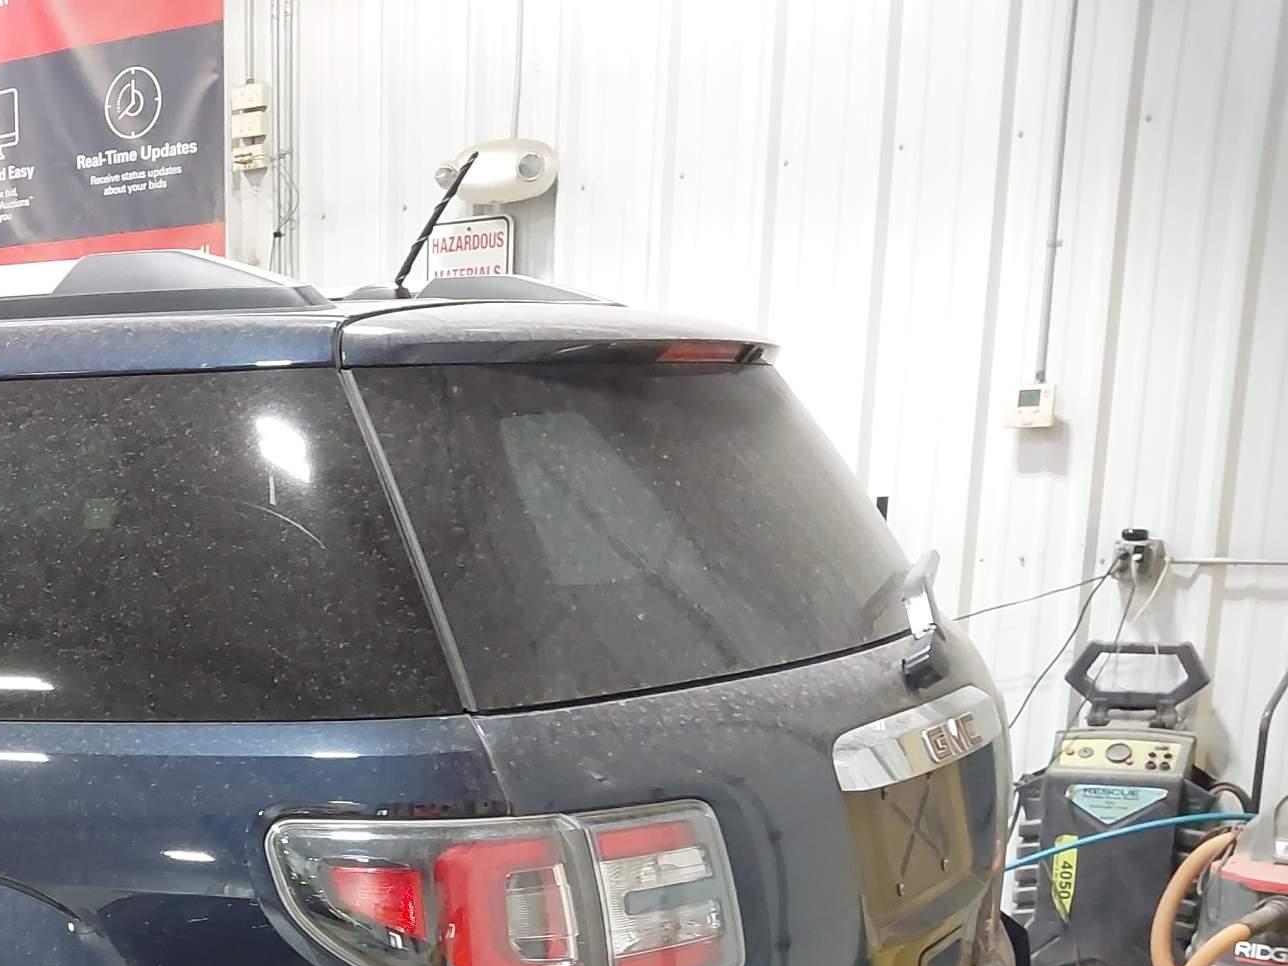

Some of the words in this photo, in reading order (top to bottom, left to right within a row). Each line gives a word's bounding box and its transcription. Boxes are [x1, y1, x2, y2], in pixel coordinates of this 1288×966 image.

[76, 150, 138, 169] Real-Time
[140, 142, 198, 162] Updates
[8, 165, 35, 180] Easy
[90, 173, 121, 185] Receive
[121, 170, 146, 181] status
[147, 166, 183, 178] updates
[103, 185, 127, 196] about
[127, 182, 147, 195] your
[148, 179, 168, 190] bids
[432, 230, 505, 254] HAZARDOUS
[921, 711, 984, 763] GMC
[1058, 860, 1073, 900] 4050
